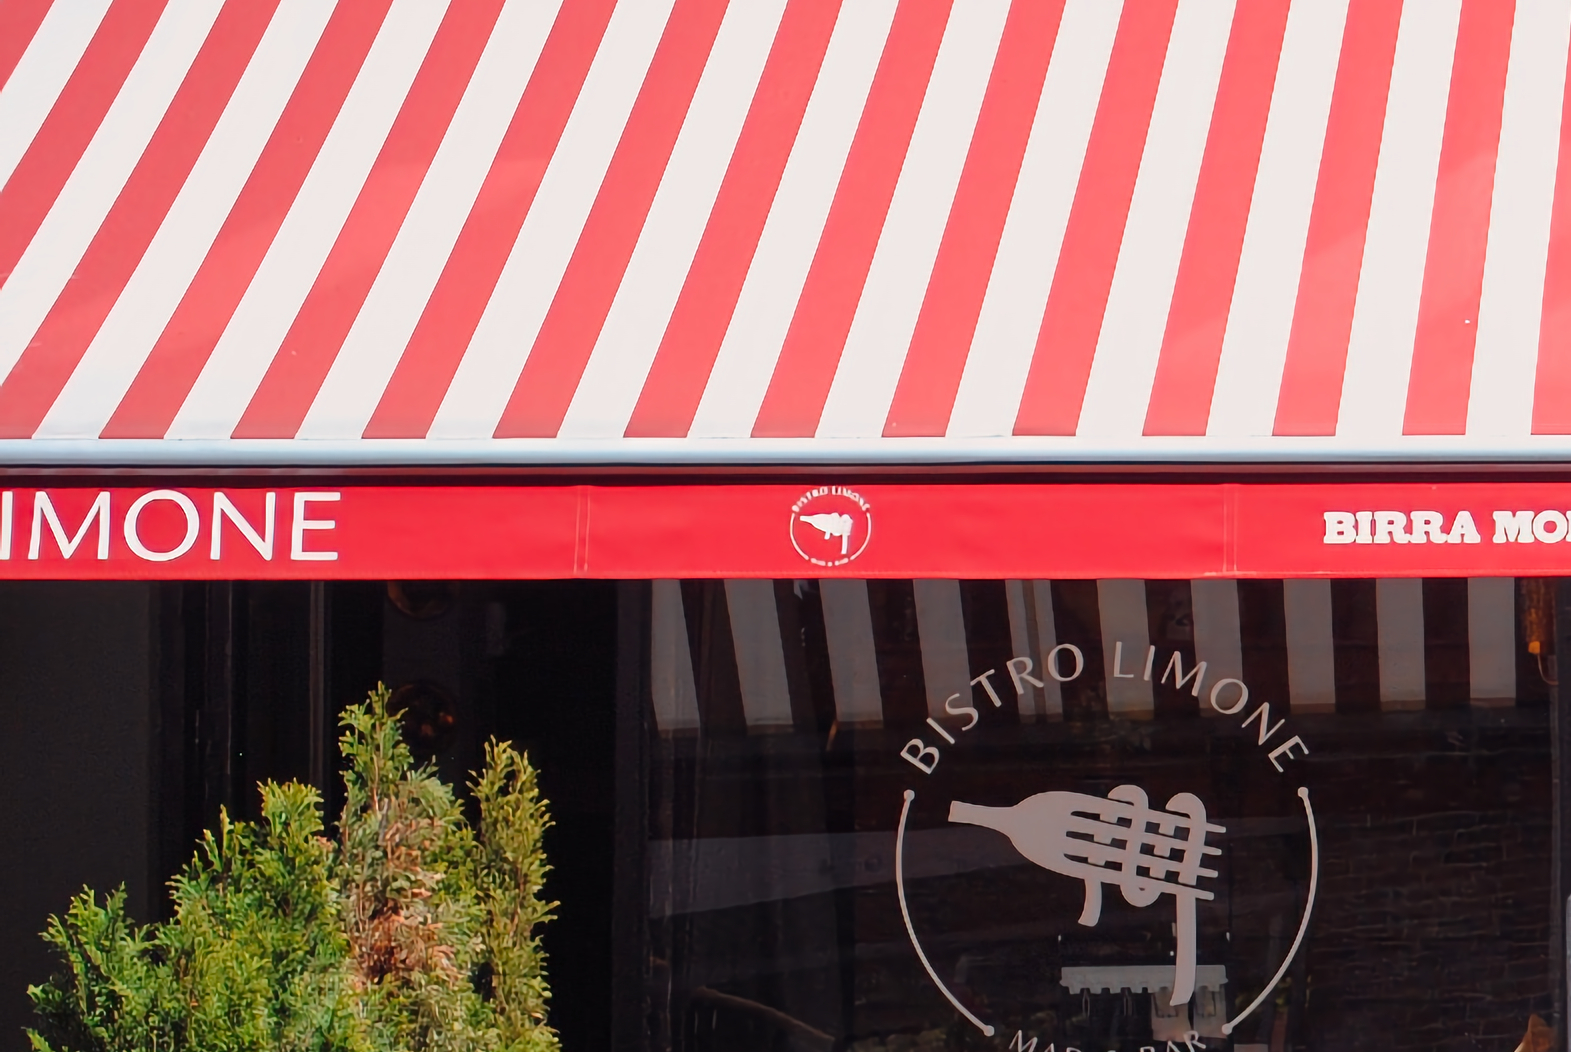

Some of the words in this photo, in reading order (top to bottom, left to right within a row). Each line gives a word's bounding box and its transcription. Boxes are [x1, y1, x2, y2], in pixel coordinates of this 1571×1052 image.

[0, 489, 341, 562] IMONE
[1323, 510, 1482, 545] BIRRA
[900, 643, 1085, 775] BISTRO
[1112, 640, 1310, 773] LIMONE
